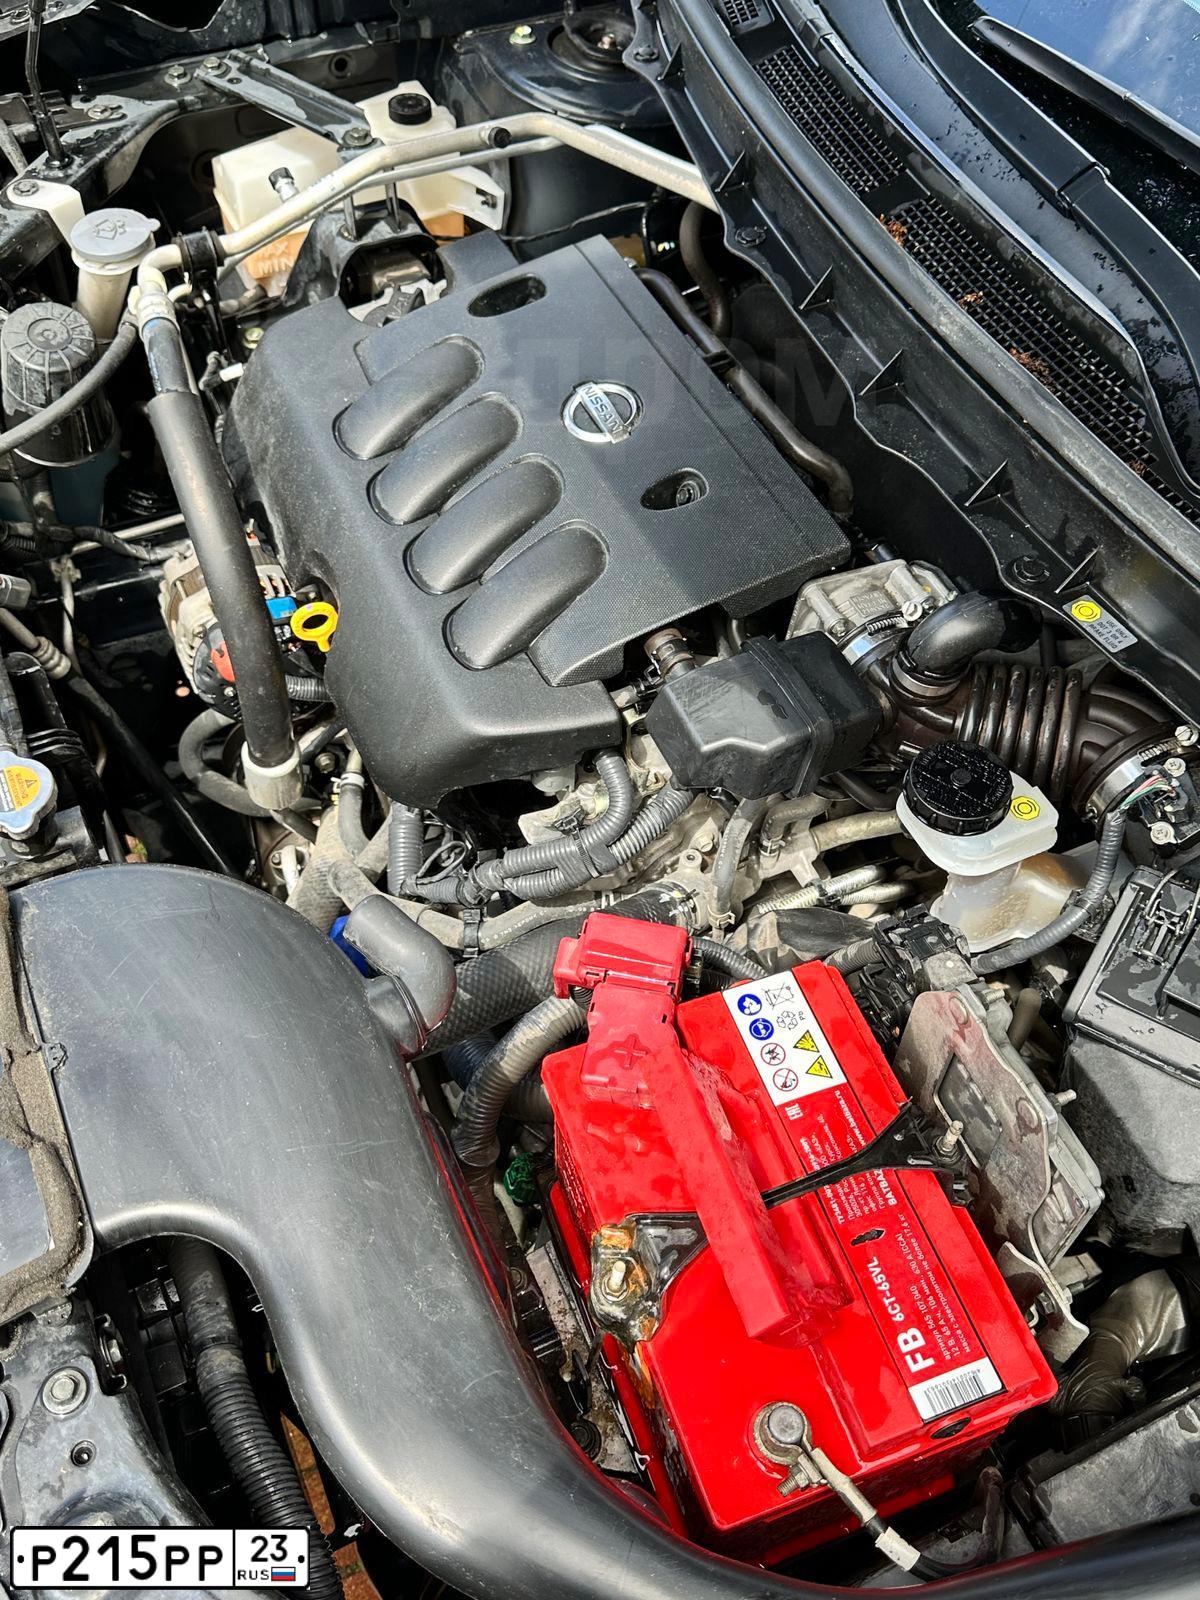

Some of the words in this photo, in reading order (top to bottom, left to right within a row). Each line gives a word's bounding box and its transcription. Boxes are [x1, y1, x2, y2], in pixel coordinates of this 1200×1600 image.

[582, 386, 623, 434] NISSAN
[1097, 621, 1108, 630] DOT
[1106, 620, 1117, 629] USE
[1115, 628, 1128, 639] ONLY
[1088, 623, 1105, 638] BRAKE
[1103, 636, 1118, 649] FLUID
[15, 773, 29, 799] WARNING
[873, 1168, 897, 1205] BATBAZ
[831, 1180, 855, 1219] Производи
[897, 1212, 905, 1221] кг
[909, 1237, 924, 1260] более
[909, 1260, 920, 1274] 630
[920, 1259, 930, 1270] не
[909, 1284, 921, 1299] 040
[926, 1269, 956, 1322] электролитом
[916, 1299, 928, 1313] 107
[926, 1295, 938, 1309] 106
[923, 1314, 935, 1329] 565
[941, 1325, 951, 1336] 65
[896, 1327, 935, 1373] FB
[932, 1329, 952, 1360] артикул
[950, 1345, 960, 1355] 12
[955, 1329, 971, 1352] масса
